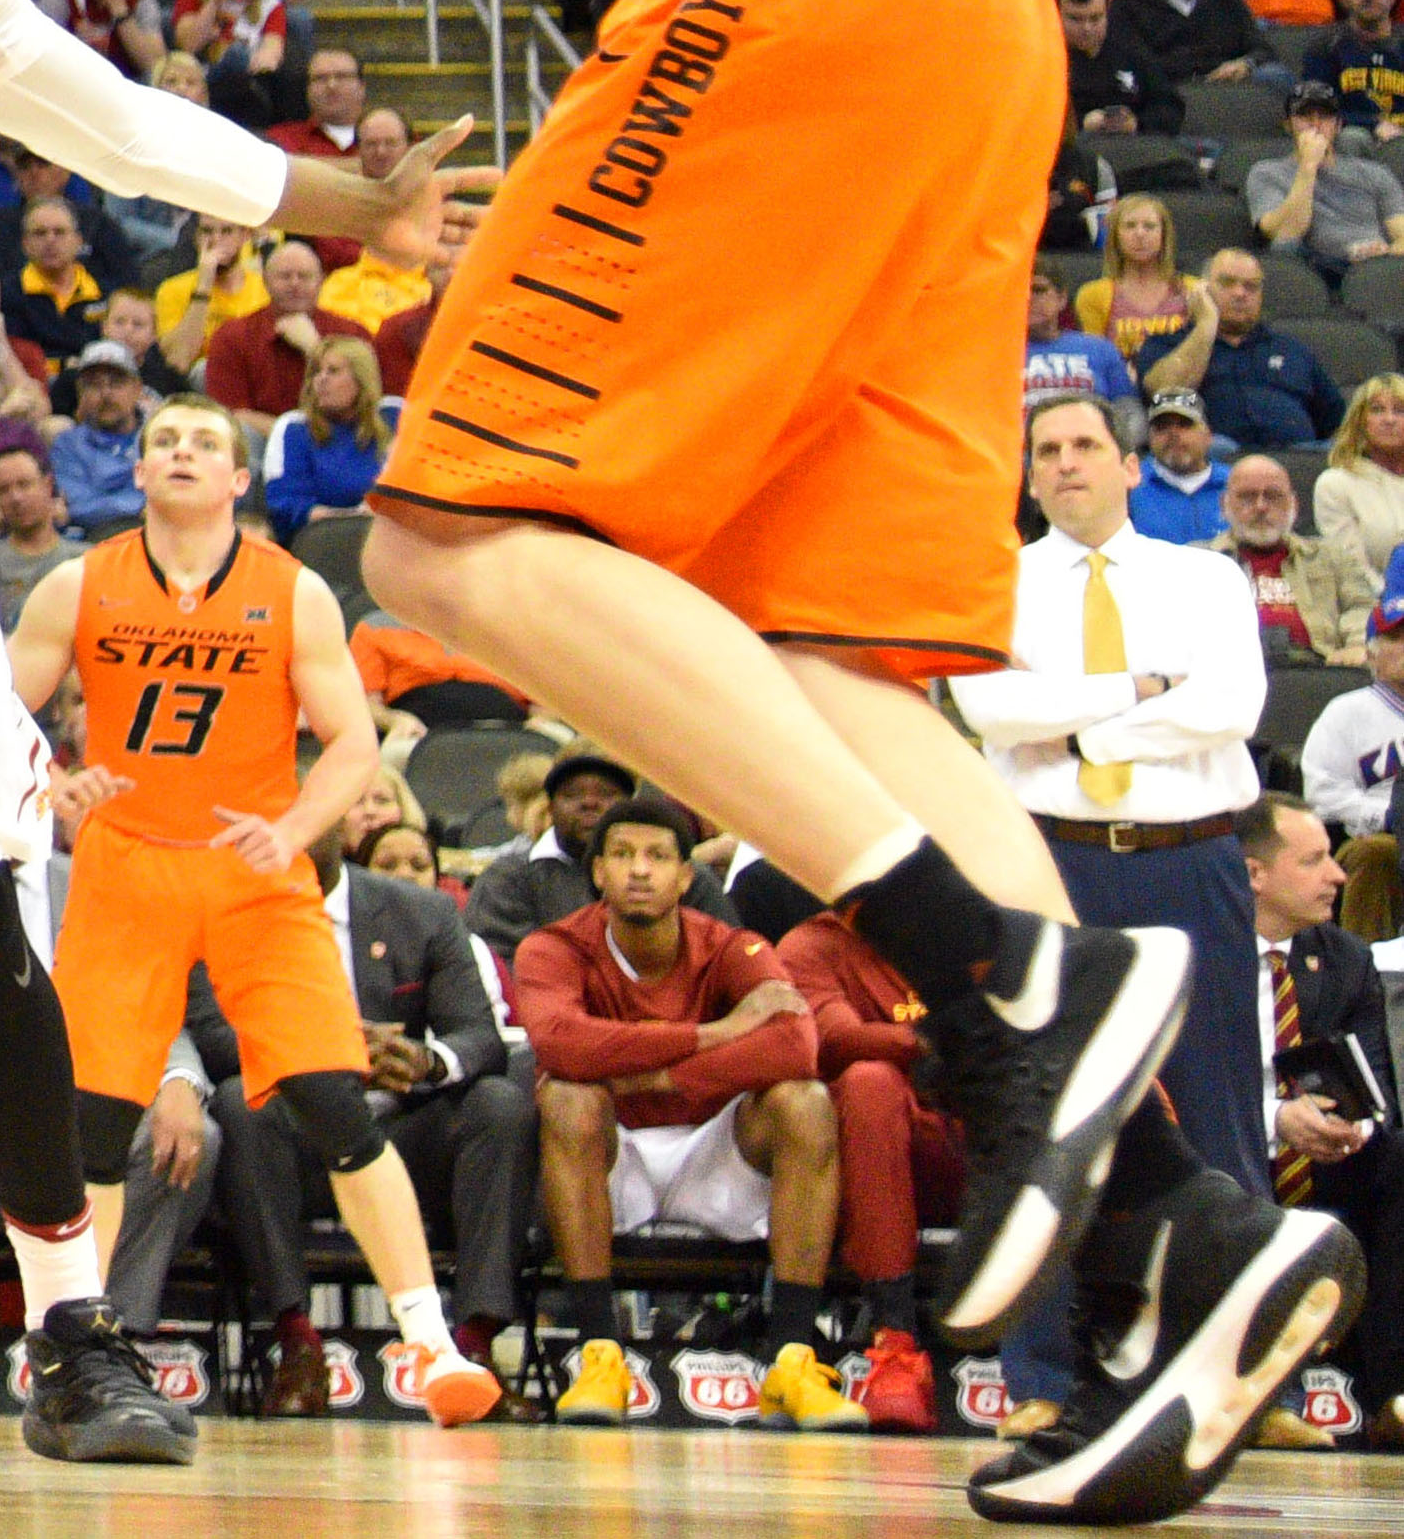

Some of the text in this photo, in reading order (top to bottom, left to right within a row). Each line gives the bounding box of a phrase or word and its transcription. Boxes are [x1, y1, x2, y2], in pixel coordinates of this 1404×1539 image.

[112, 622, 256, 644] OKLAHOMA
[93, 637, 268, 675] STATE
[123, 680, 226, 758] 13
[697, 1377, 751, 1408] 66
